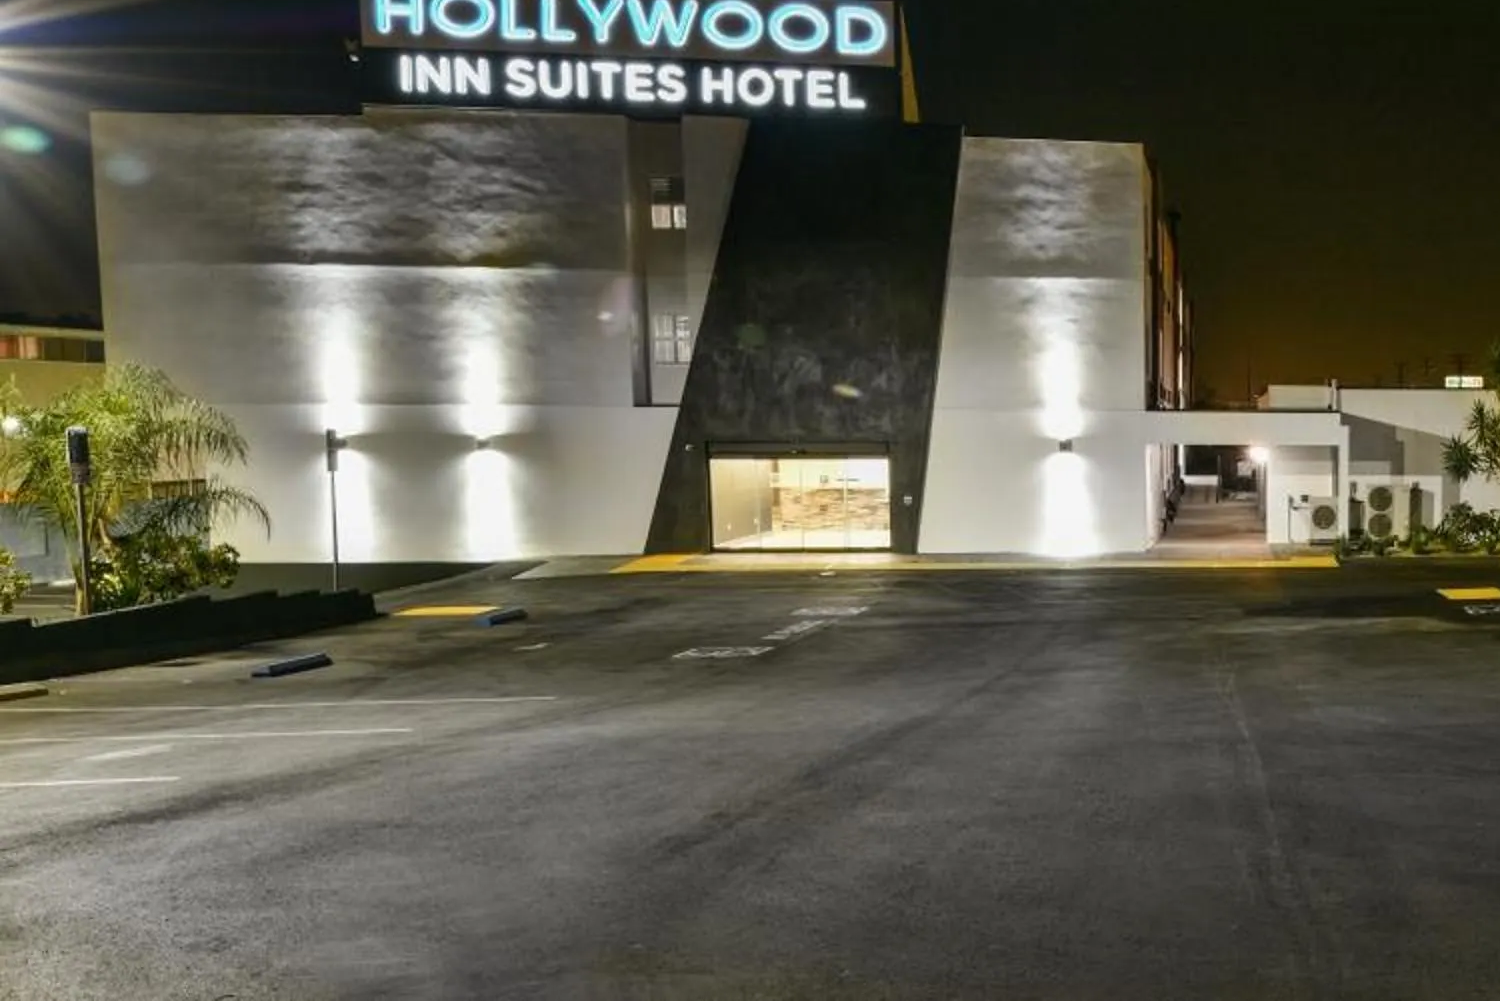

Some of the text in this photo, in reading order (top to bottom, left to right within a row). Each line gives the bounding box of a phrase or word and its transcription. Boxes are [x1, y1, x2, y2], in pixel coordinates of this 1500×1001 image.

[399, 54, 867, 110] INN SUITES HOTEL
